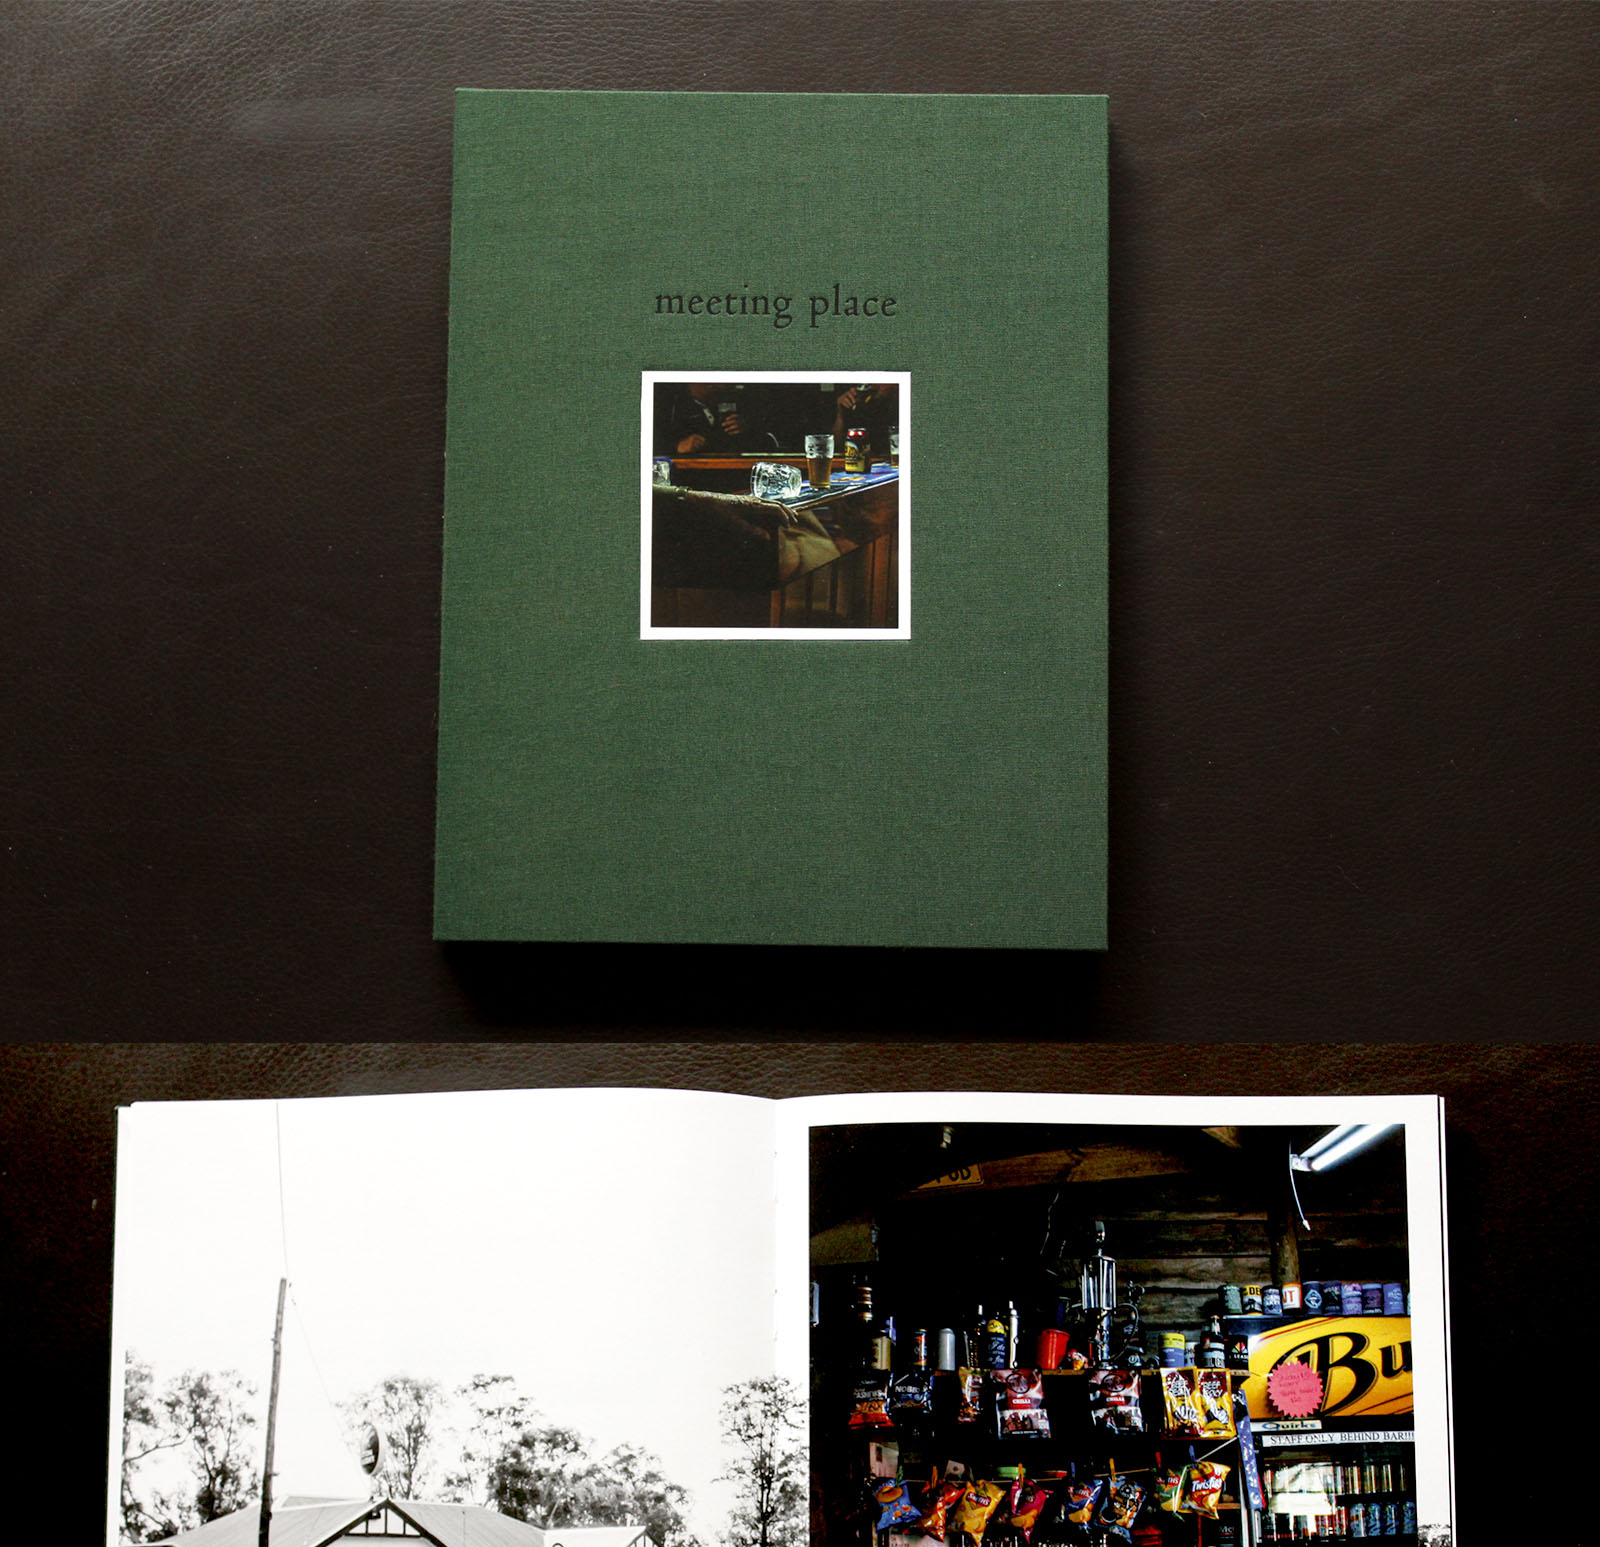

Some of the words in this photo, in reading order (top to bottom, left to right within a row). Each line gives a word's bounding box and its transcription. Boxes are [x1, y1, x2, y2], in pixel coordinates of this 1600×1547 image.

[654, 284, 794, 329] meeting
[808, 283, 898, 329] place
[1262, 1421, 1317, 1431] Quirks
[1270, 1434, 1305, 1445] STAFF
[1305, 1433, 1334, 1444] ONLY
[1340, 1431, 1380, 1442] BEHIND
[1383, 1431, 1414, 1441] BAR!!!
